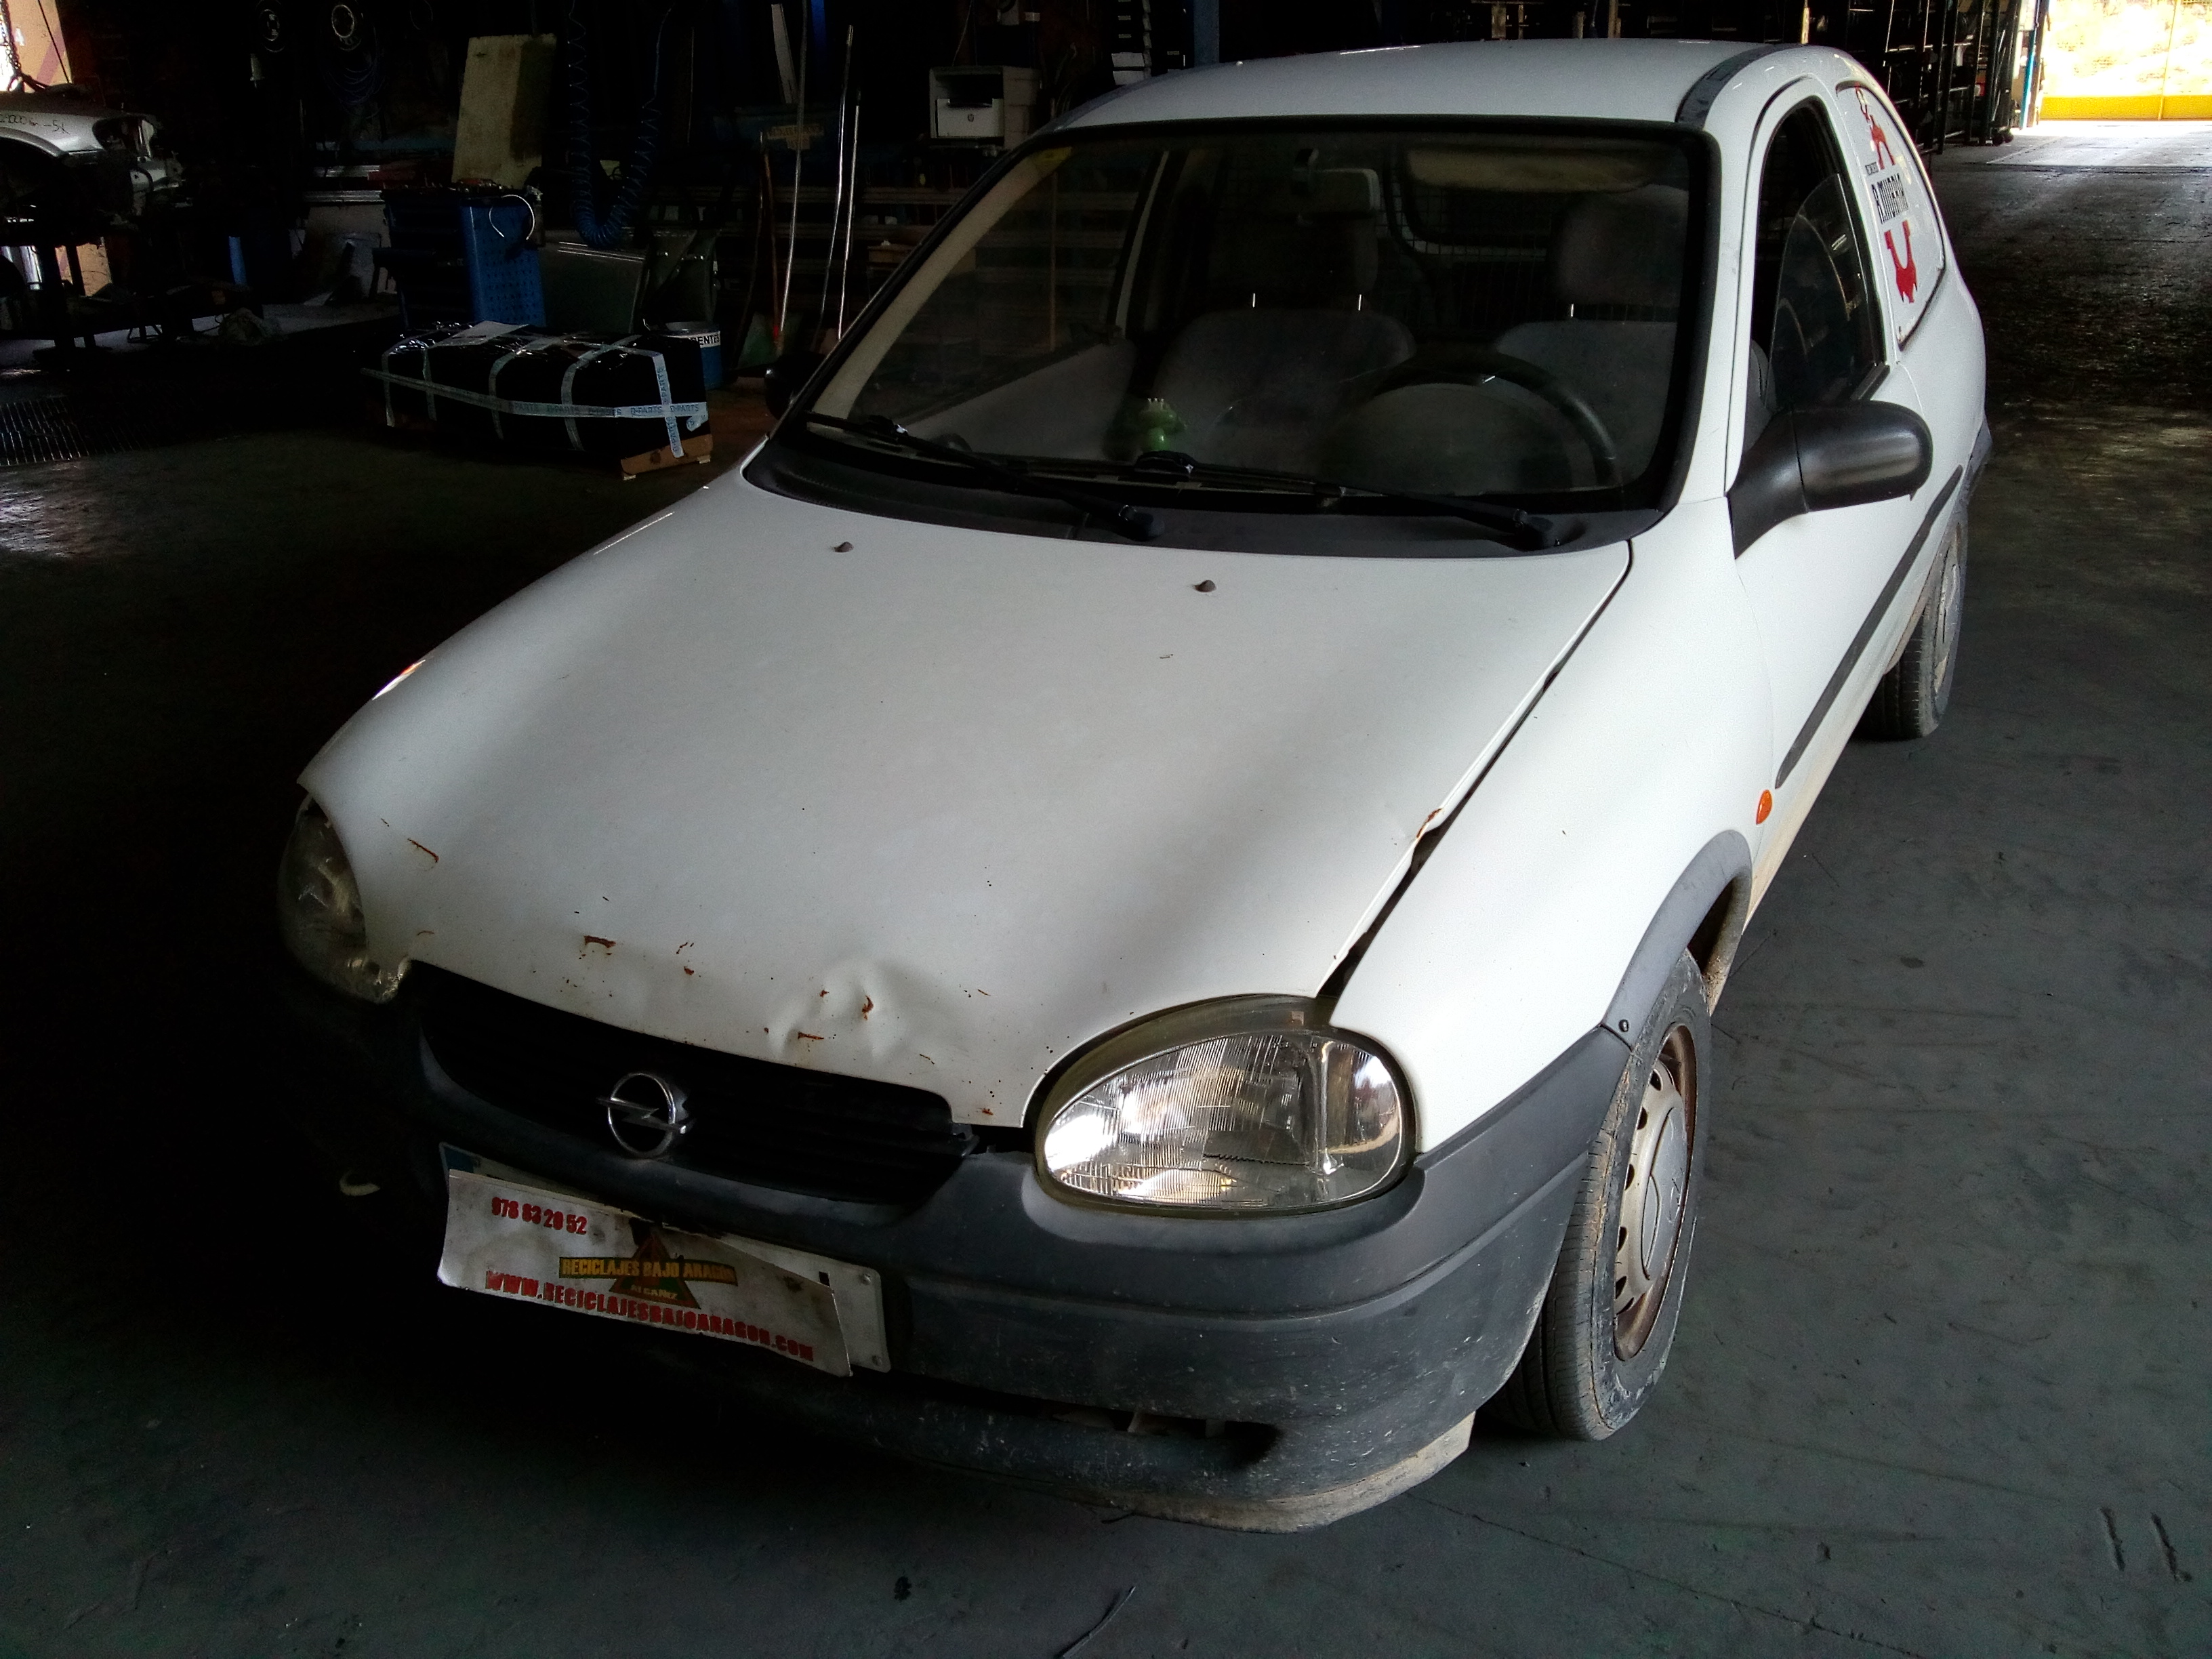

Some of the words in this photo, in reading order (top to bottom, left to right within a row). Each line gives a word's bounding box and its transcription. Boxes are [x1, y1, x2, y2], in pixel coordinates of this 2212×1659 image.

[491, 1196, 518, 1219] 978
[544, 1209, 564, 1230] 20
[566, 1214, 588, 1235] 52
[561, 1258, 640, 1276] RECICLAJES
[643, 1261, 680, 1277] BAJO
[485, 1270, 814, 1362] WWW.RECICLAJESBAJOARAGON.COM
